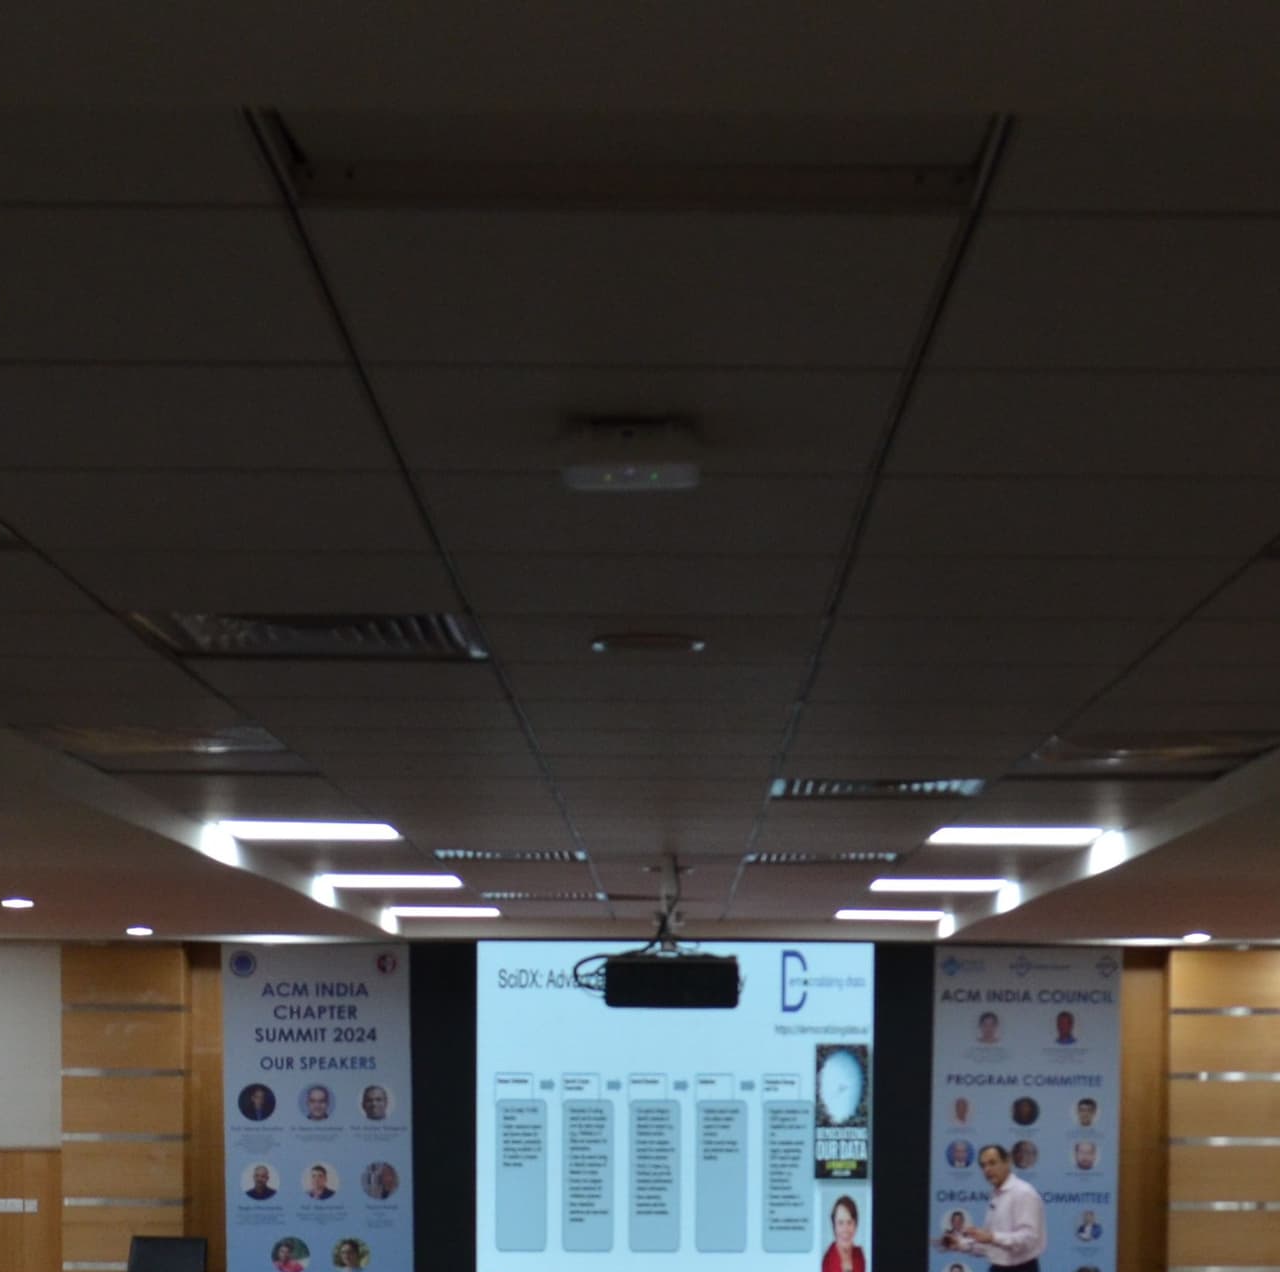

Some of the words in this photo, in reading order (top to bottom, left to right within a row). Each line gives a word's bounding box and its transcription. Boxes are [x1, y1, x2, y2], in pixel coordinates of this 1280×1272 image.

[261, 982, 309, 998] ACM
[314, 982, 369, 998] INDIA
[940, 989, 982, 1003] ACM
[986, 989, 1032, 1003] INDIA
[1037, 989, 1113, 1005] COUNCIL
[273, 1005, 358, 1021] CHAPTER
[254, 1027, 327, 1043] SUMMIT
[333, 1027, 378, 1043] 2024
[260, 1056, 295, 1072] OUR
[299, 1055, 377, 1071] SPEAKERS
[946, 1073, 1019, 1088] PROGRAM
[1023, 1074, 1103, 1089] COMMITTEE
[936, 1189, 990, 1203] ORGAN
